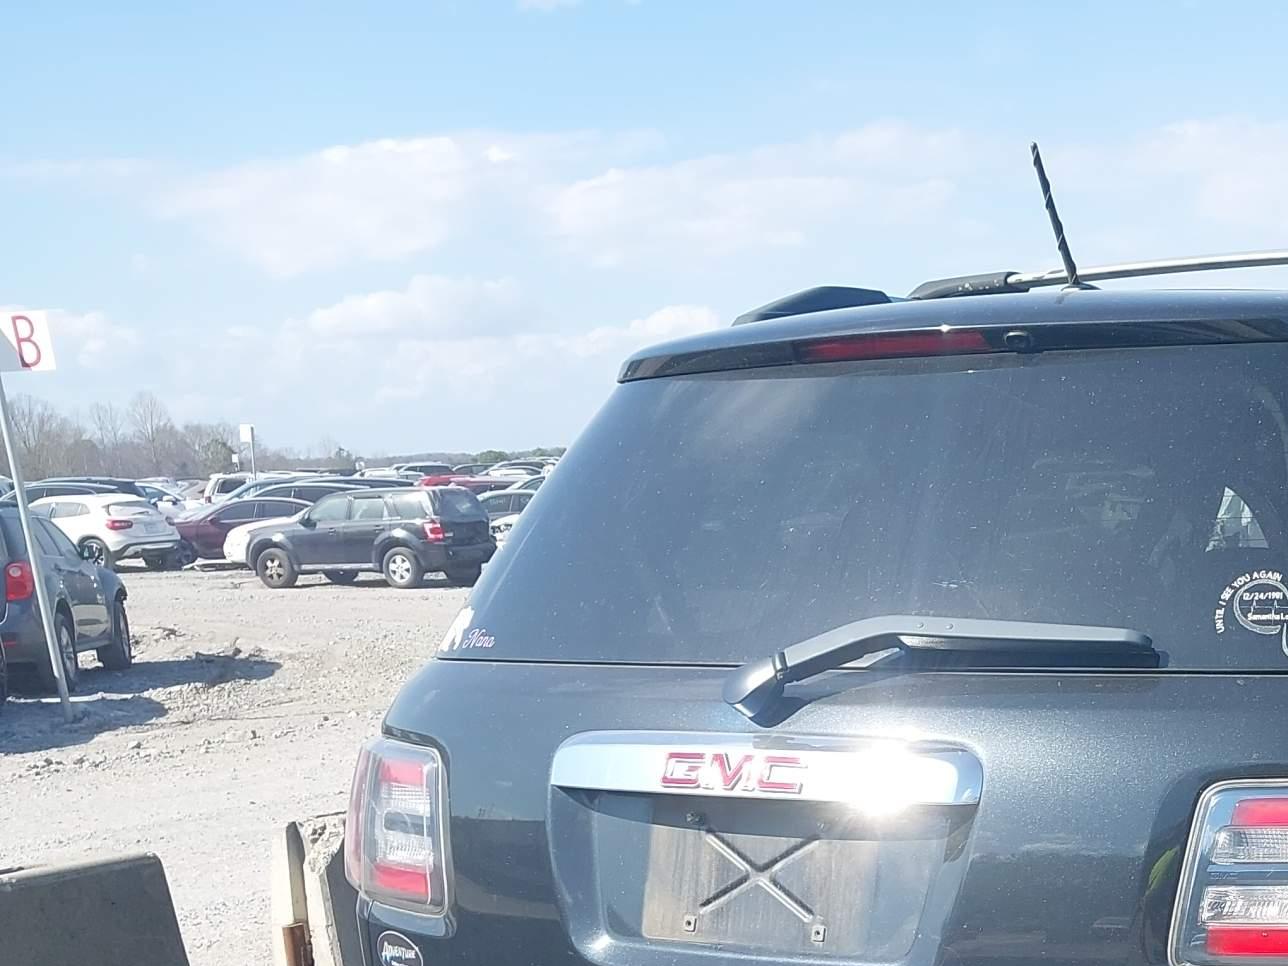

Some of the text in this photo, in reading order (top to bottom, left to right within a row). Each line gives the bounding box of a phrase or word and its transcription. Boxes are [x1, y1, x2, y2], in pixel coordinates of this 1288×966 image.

[11, 315, 41, 368] B
[1214, 608, 1225, 634] UNTIL
[1220, 586, 1235, 601] SEE
[1232, 573, 1251, 588] YOU
[1252, 570, 1283, 582] AGAIN
[462, 628, 496, 649] Nana
[661, 752, 808, 794] GMC
